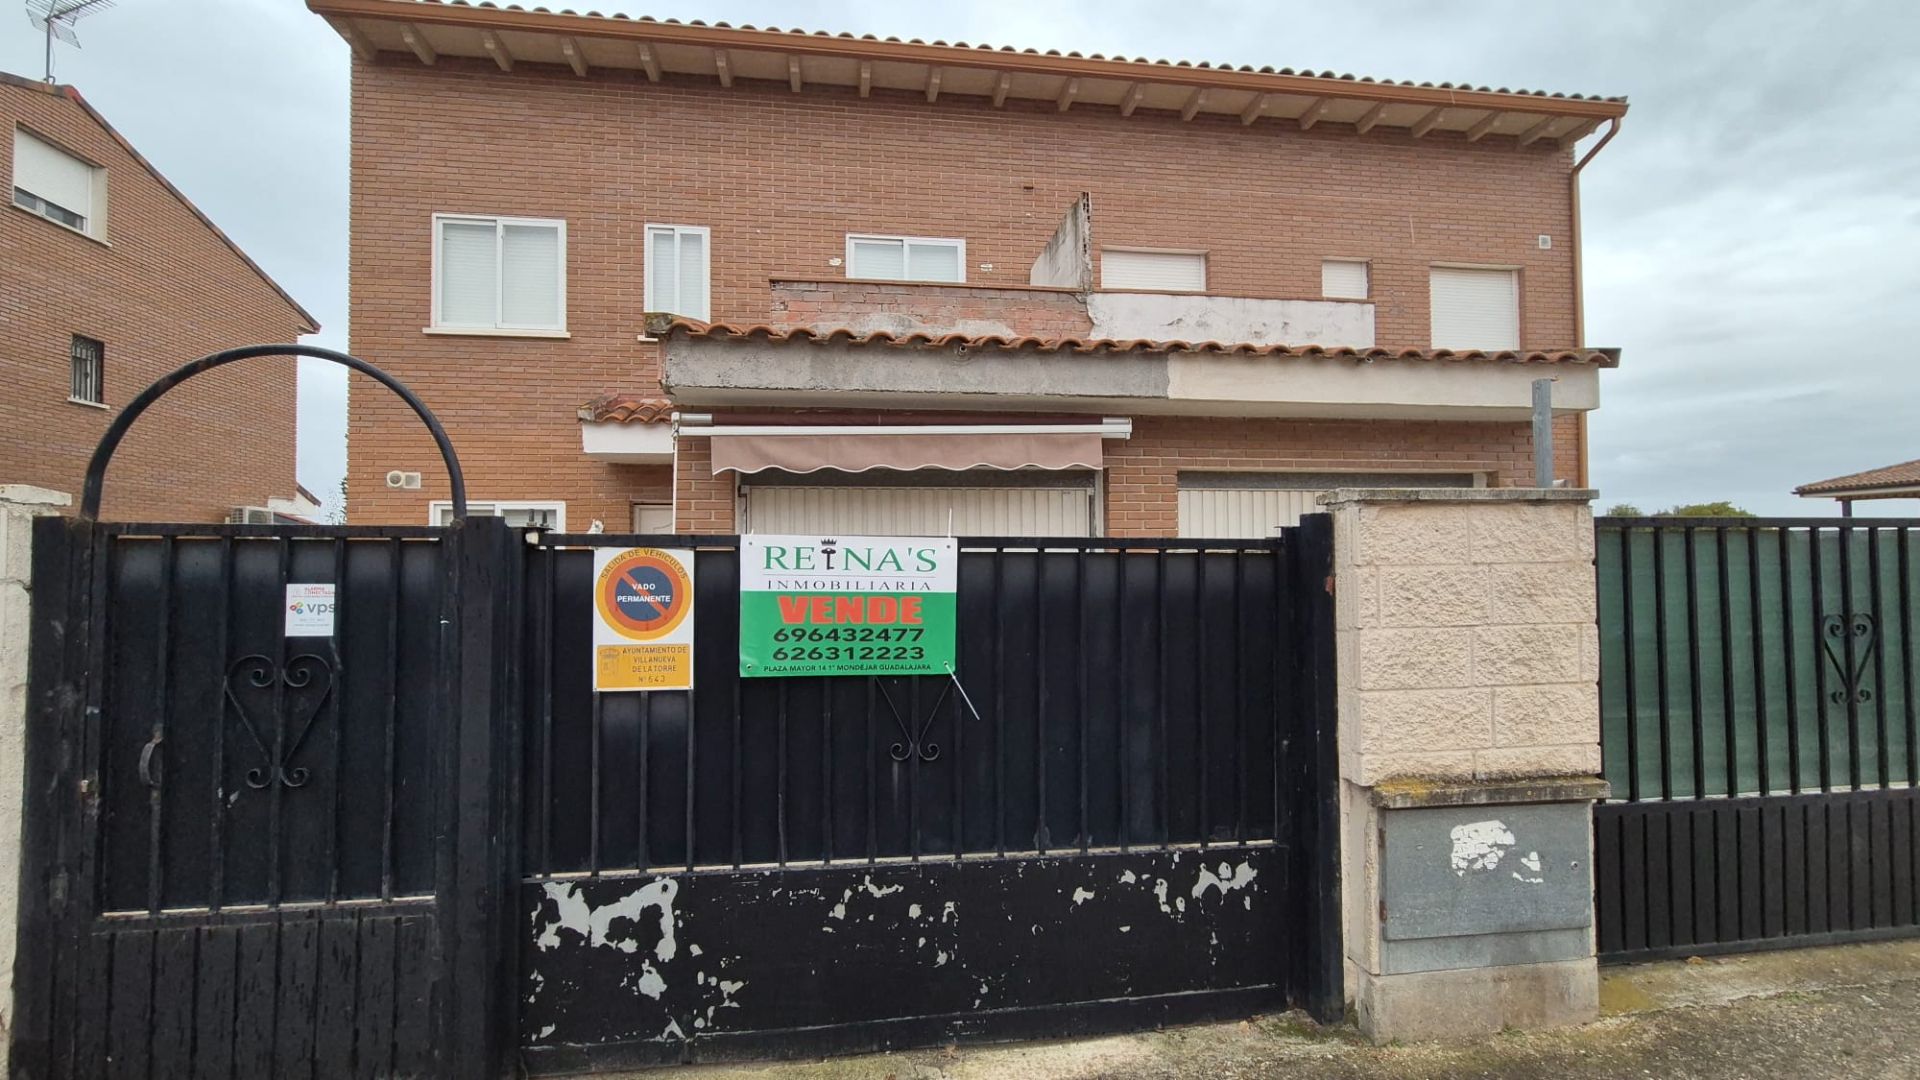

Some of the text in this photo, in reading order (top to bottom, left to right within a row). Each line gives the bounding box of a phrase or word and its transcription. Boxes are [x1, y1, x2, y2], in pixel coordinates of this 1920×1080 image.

[601, 548, 688, 579] SALIDA DE VEHICULOS
[768, 580, 931, 591] INMOBILIARIA
[617, 595, 671, 603] PERMANENTE
[307, 603, 335, 615] vps
[777, 596, 923, 624] VENDE
[773, 628, 925, 643] 696432477
[623, 646, 676, 654] AYUNTAMIENTO
[772, 646, 924, 661] 626312223
[633, 656, 676, 664] VILLANUEVA
[654, 664, 677, 672] TORRE
